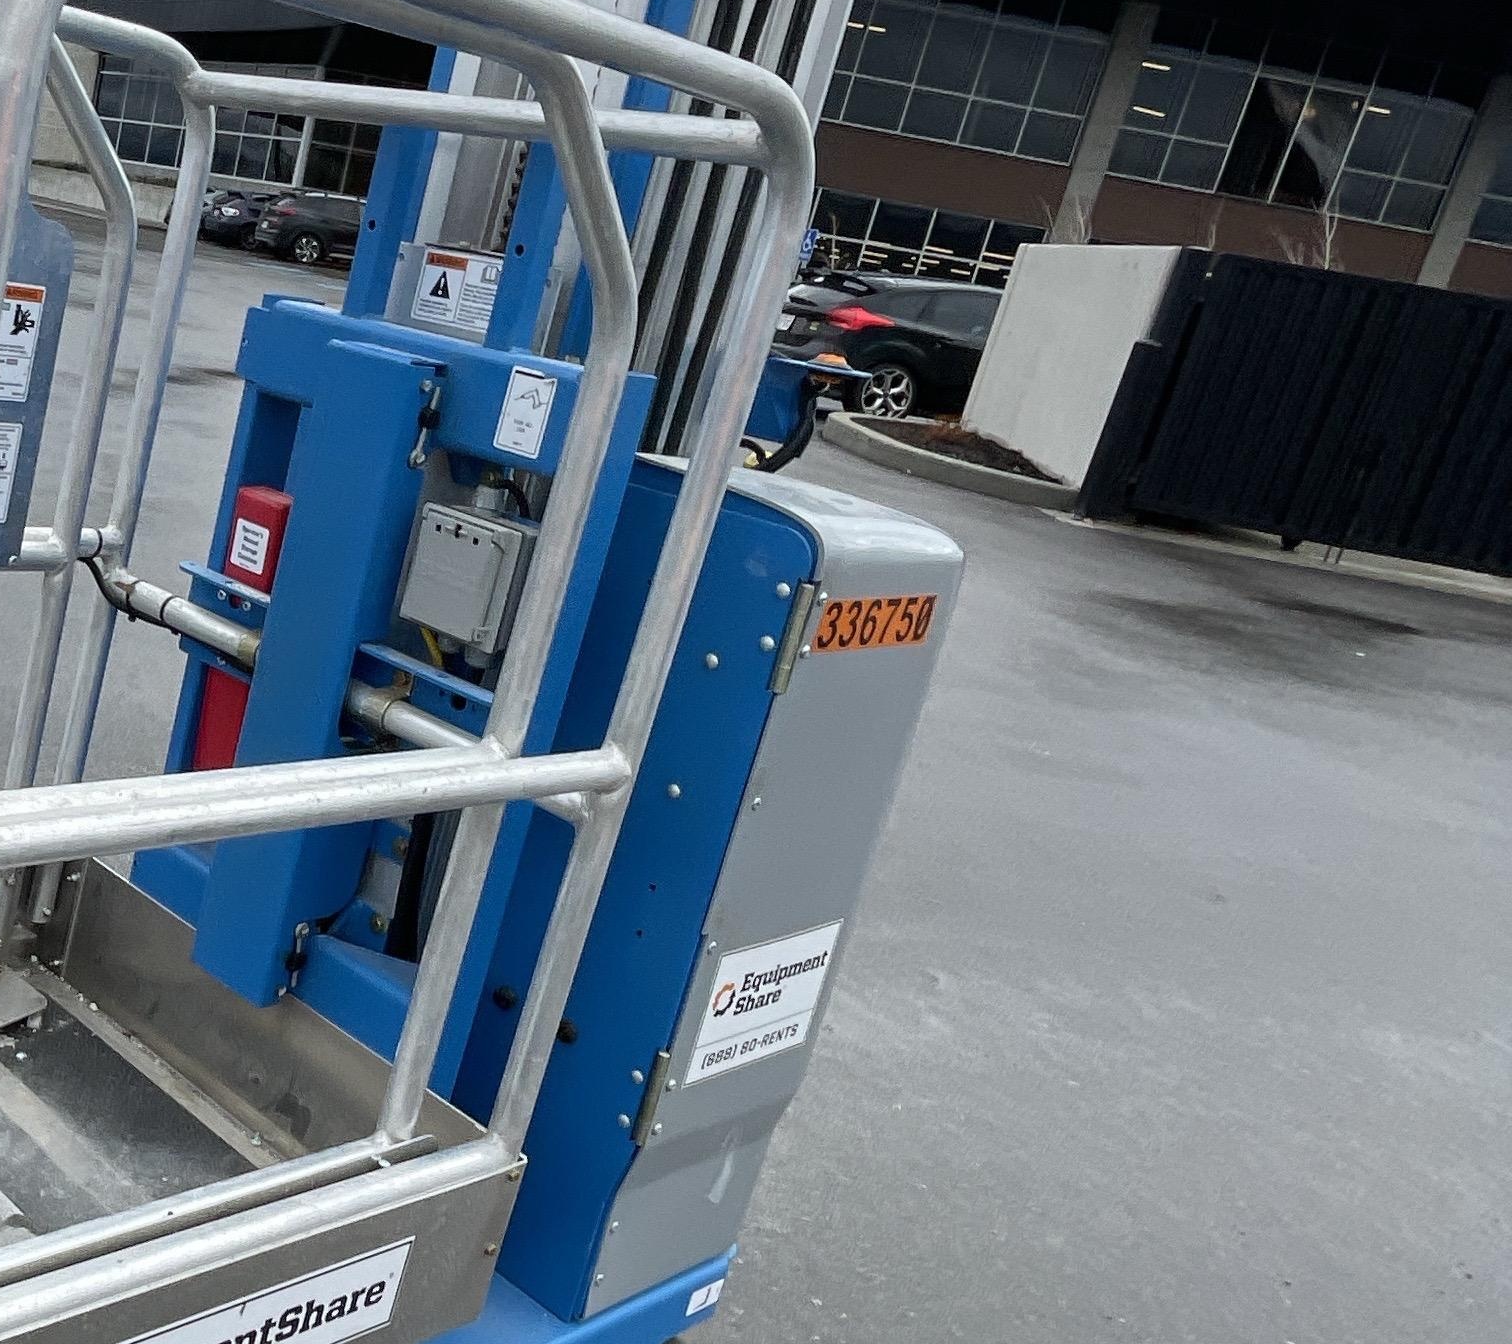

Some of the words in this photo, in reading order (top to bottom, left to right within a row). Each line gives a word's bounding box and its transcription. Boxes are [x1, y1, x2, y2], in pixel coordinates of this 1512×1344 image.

[817, 595, 937, 649] 336750
[740, 950, 828, 993] Equipment
[733, 989, 782, 1016] Share
[701, 1043, 737, 1070] (888)
[740, 1023, 799, 1056] 80-RENTS
